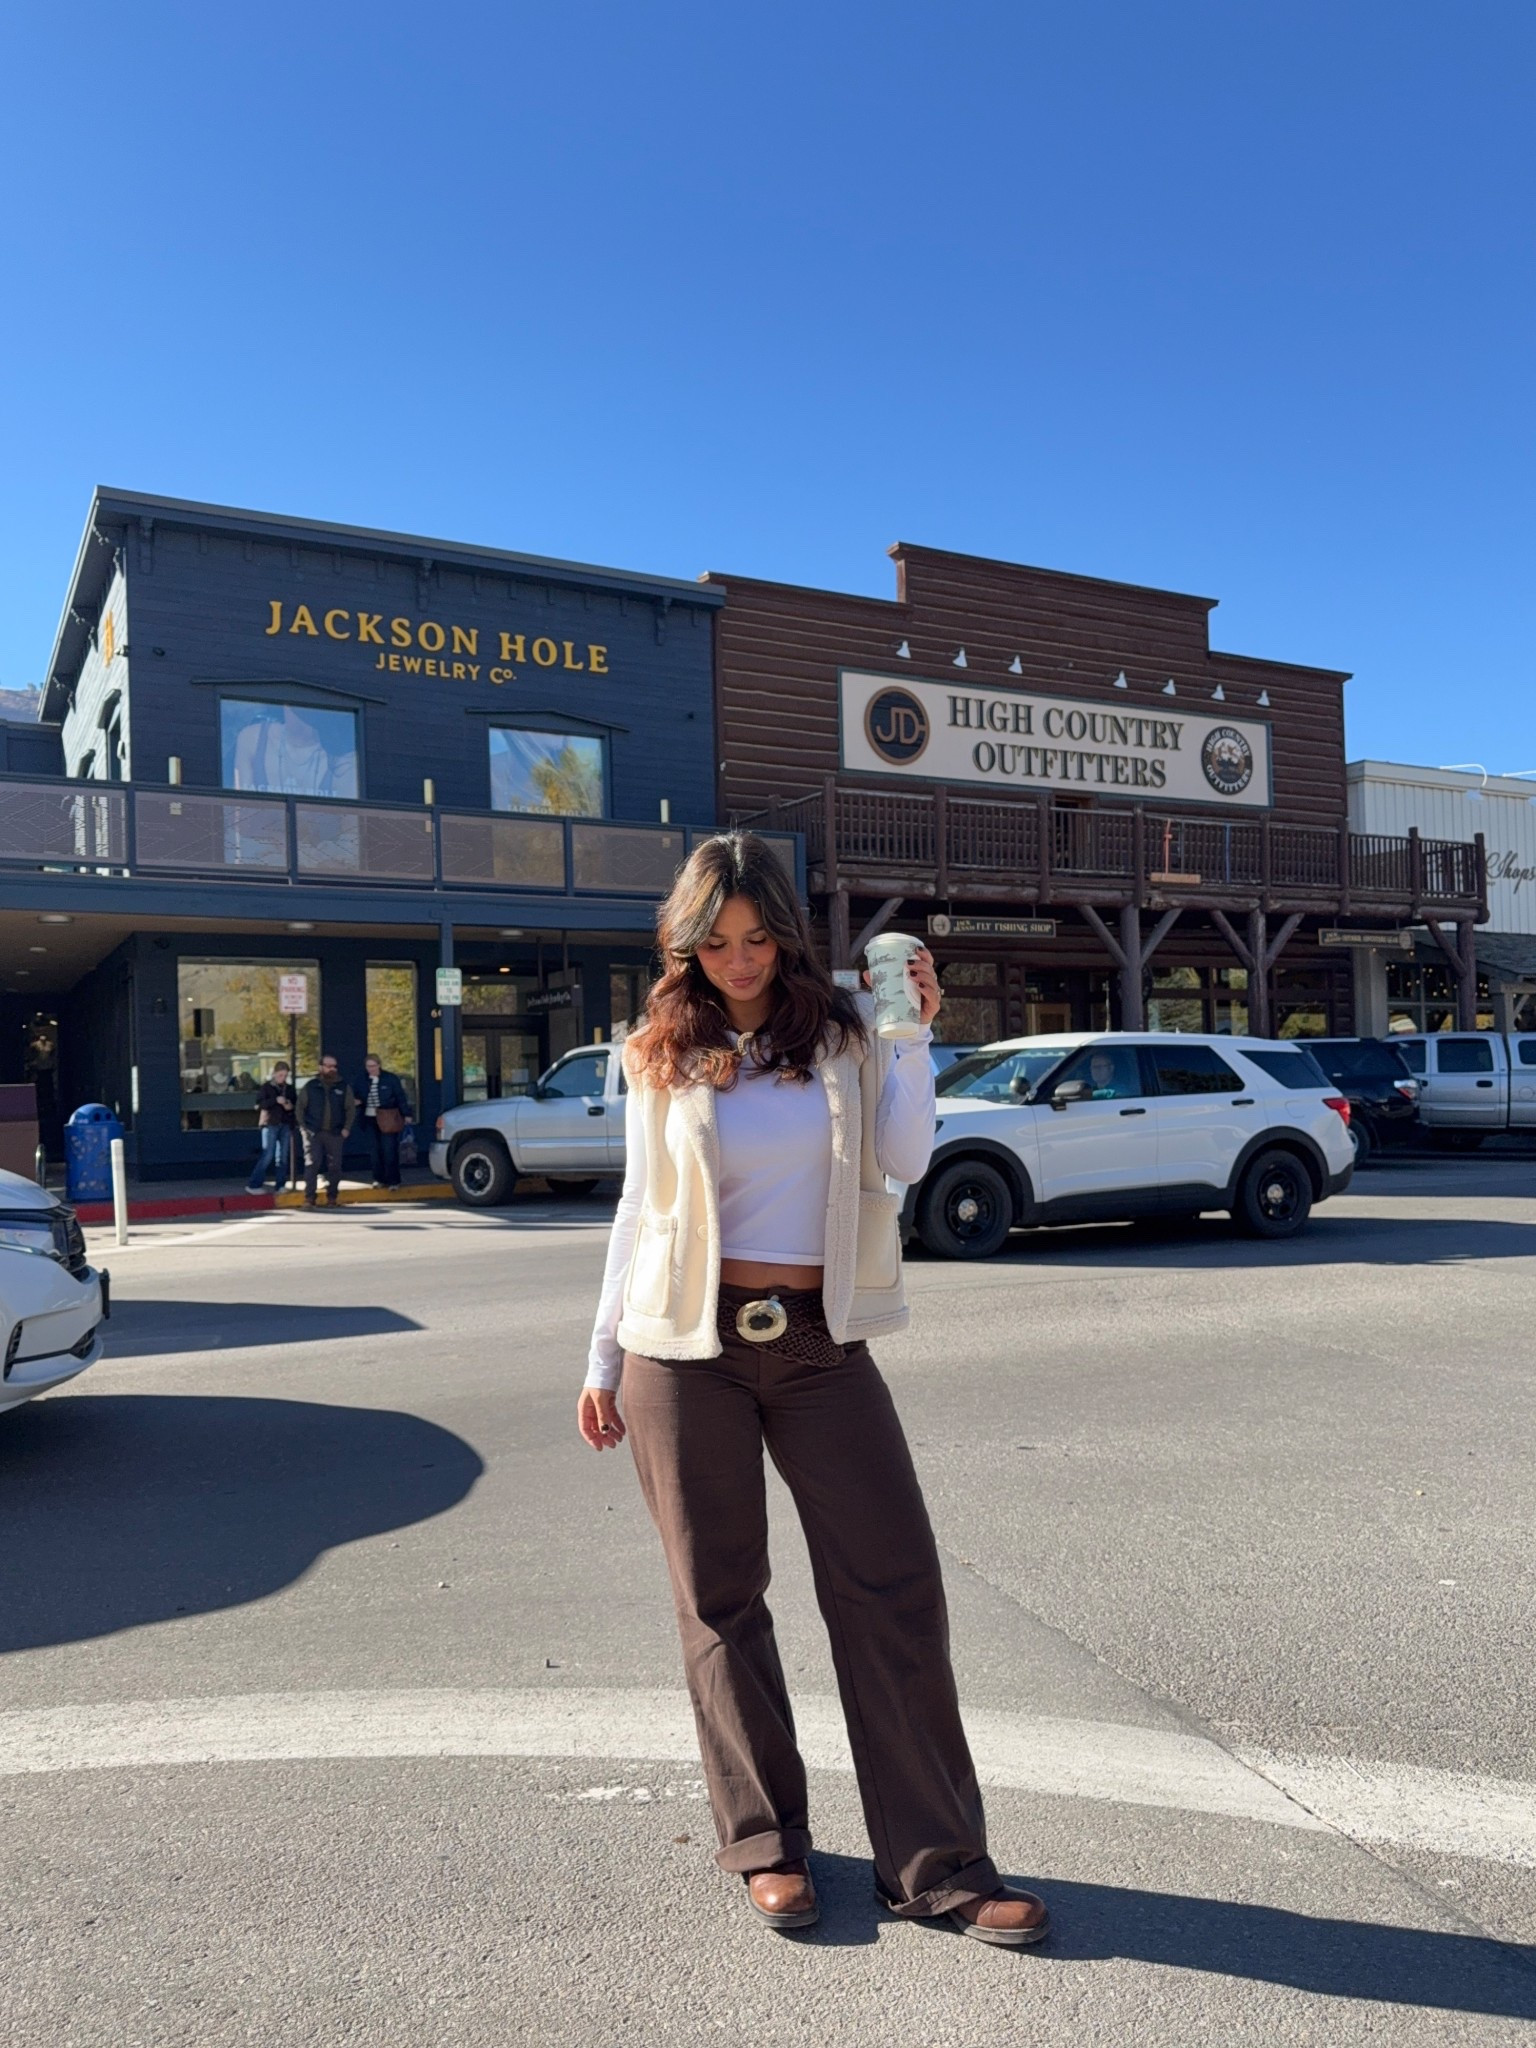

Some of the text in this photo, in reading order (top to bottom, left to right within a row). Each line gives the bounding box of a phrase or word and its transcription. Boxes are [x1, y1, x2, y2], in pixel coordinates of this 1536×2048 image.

[265, 600, 610, 674] JACKSON HOLE
[375, 652, 518, 684] JEWELRY Co.
[946, 694, 1185, 751] HIGH COUNTRY
[1205, 728, 1251, 757] HIGH COUNTRY
[971, 740, 1168, 789] OUTFITTERS
[1206, 763, 1251, 793] OUTFITTERS
[976, 922, 1052, 933] FLY FISHING SHOP
